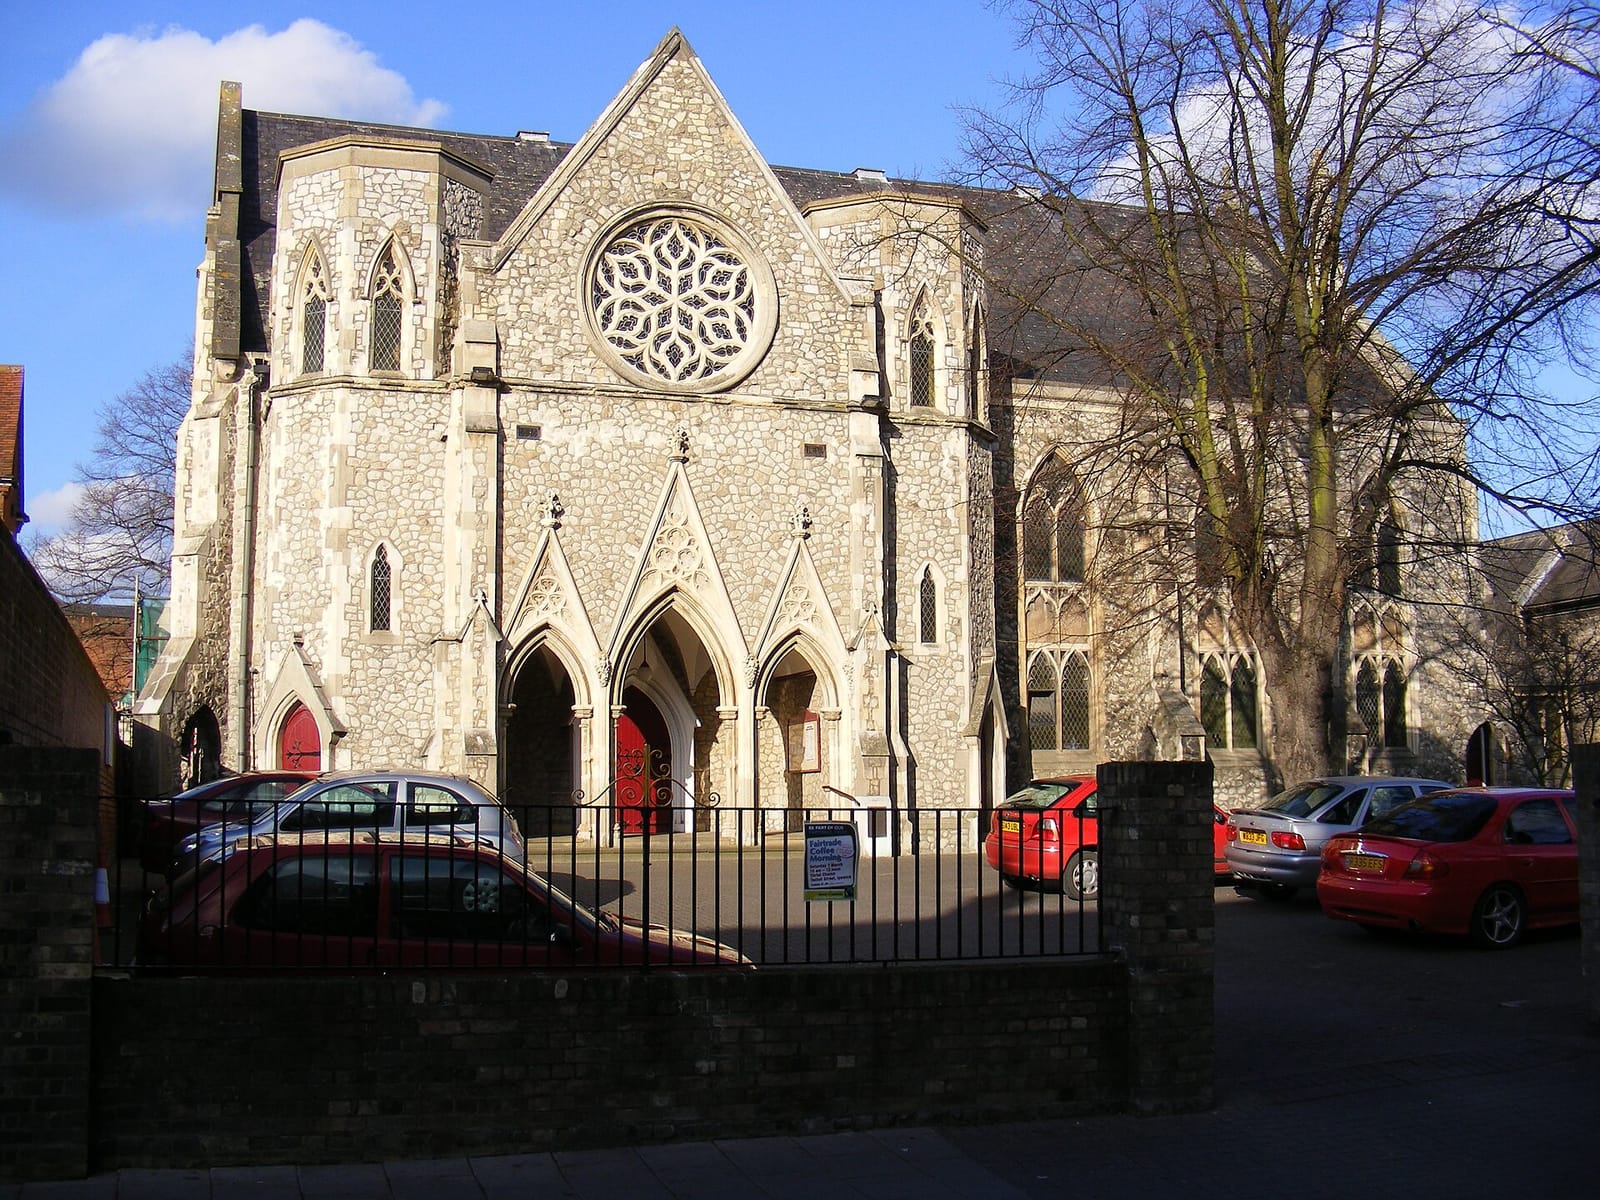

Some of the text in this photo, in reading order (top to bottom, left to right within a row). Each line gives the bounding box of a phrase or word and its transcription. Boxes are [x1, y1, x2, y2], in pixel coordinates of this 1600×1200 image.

[810, 838, 842, 848] Fairtrade
[810, 846, 835, 855] Coffee
[810, 854, 842, 863] Morning
